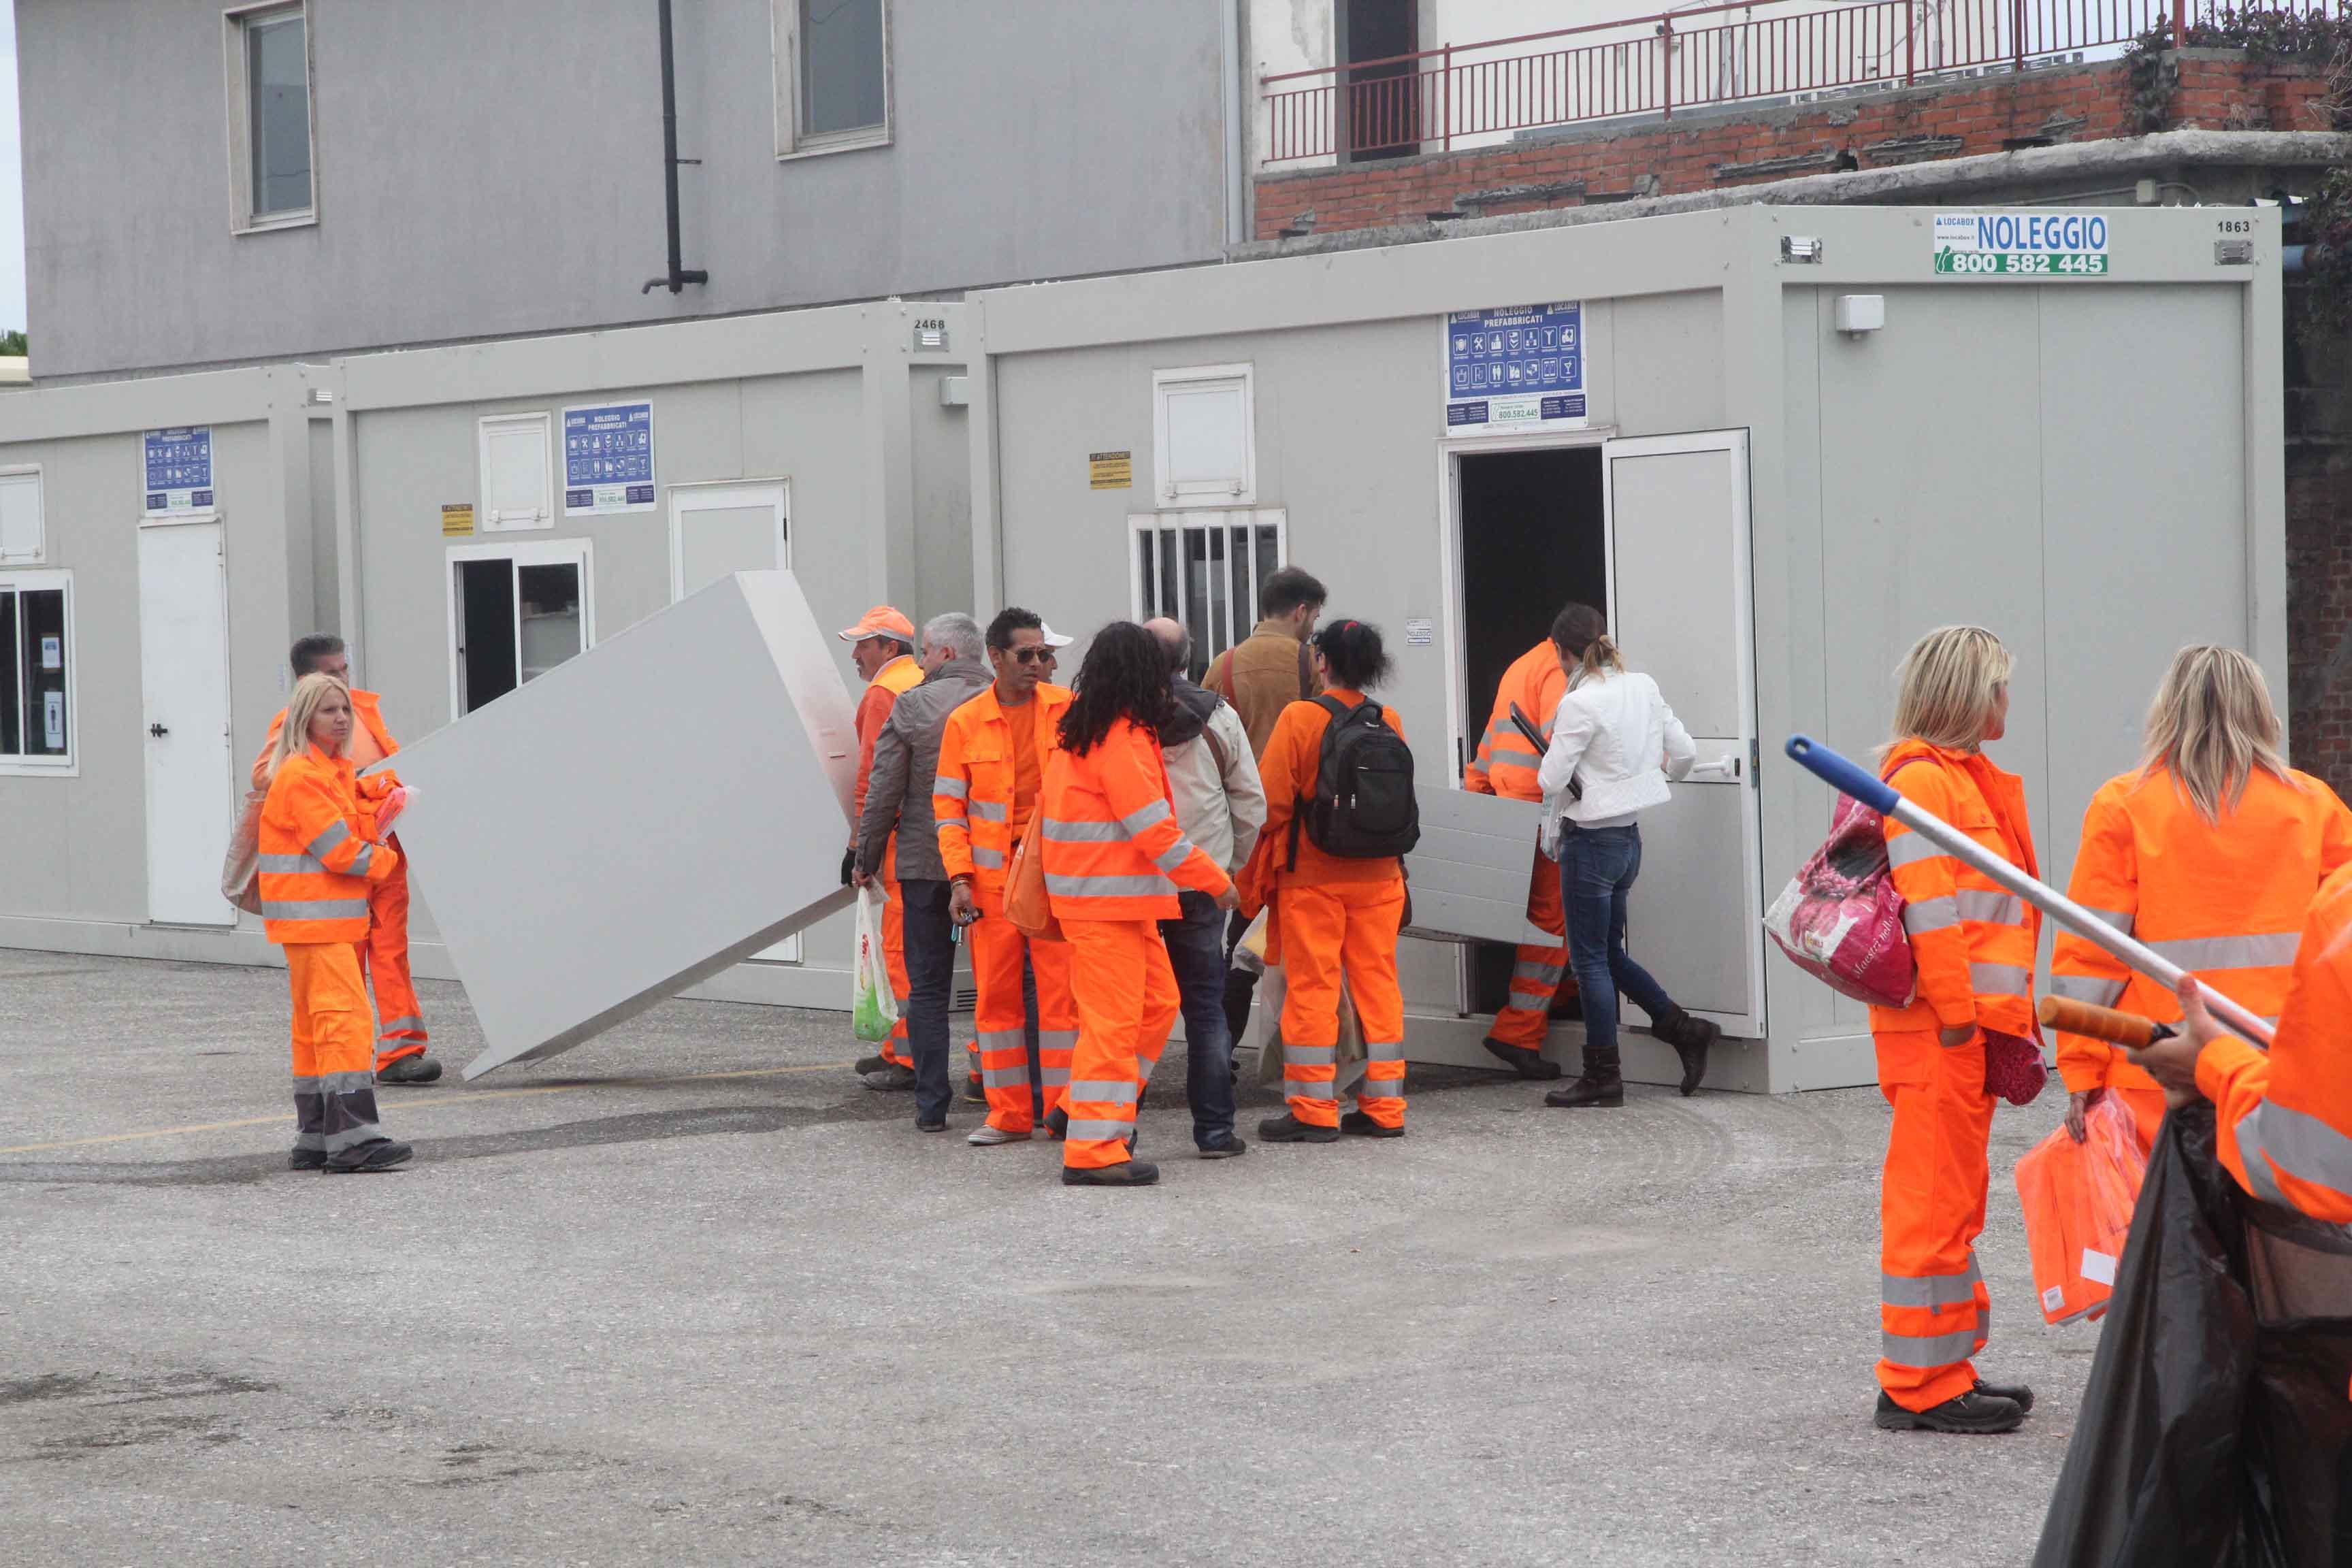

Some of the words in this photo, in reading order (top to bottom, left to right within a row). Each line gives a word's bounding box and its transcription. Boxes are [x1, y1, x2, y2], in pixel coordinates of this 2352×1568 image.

[1978, 216, 2106, 249] NOLEGGIO
[2218, 221, 2249, 232] 1863
[1953, 254, 1997, 272] 800
[2006, 254, 2051, 272] 582
[2058, 255, 2103, 272] 445
[915, 320, 945, 329] 2468
[1484, 315, 1543, 328] PREFABBRICATI
